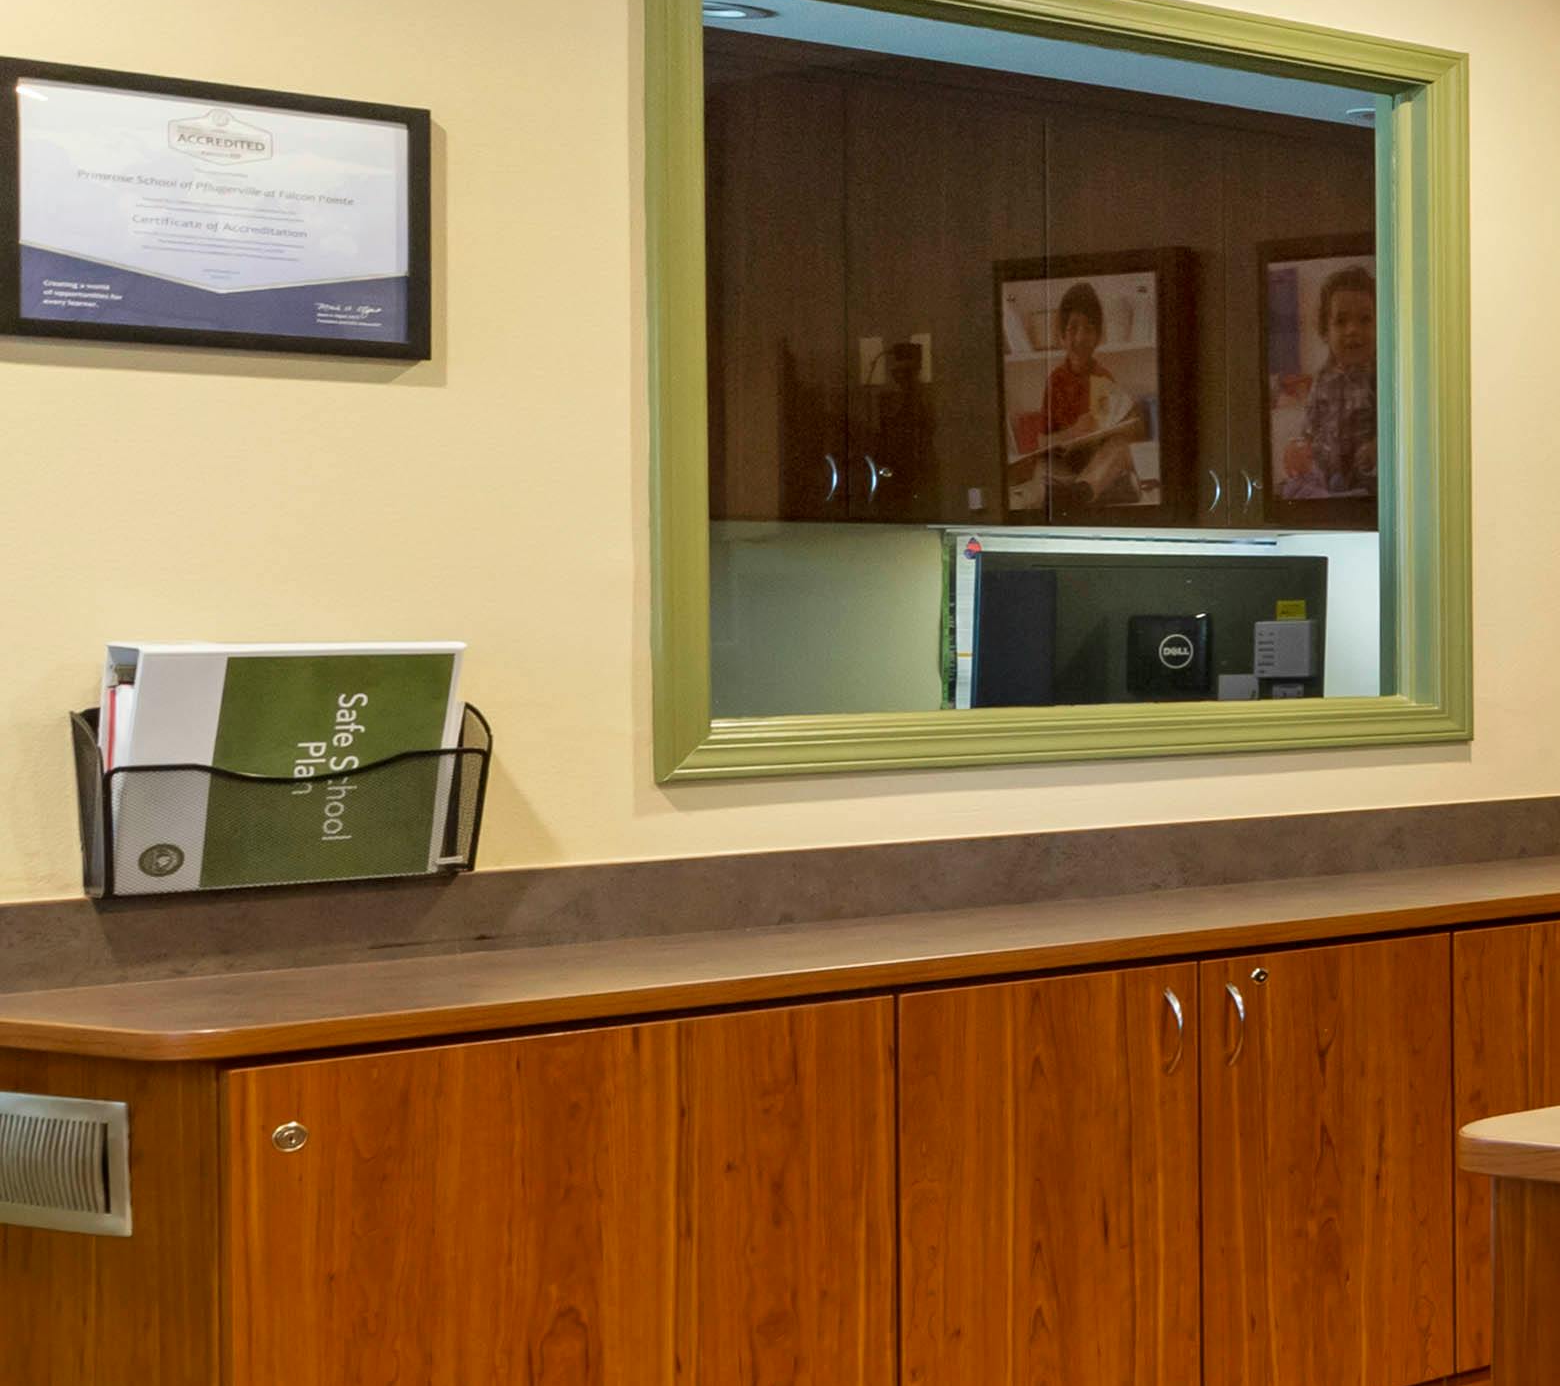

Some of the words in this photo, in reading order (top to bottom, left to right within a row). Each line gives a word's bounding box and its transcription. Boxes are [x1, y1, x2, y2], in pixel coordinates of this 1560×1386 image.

[177, 133, 265, 152] ACCREDITED
[76, 169, 133, 184] Primrose
[137, 174, 177, 189] School
[180, 180, 193, 191] of
[196, 181, 261, 198] Pflugerville
[263, 189, 275, 198] at
[279, 190, 316, 203] Falcon
[318, 194, 355, 206] Pointe
[132, 214, 203, 229] Certificate
[206, 221, 220, 233] of
[223, 222, 307, 239] Accreditation
[1163, 647, 1189, 656] DELL
[332, 692, 368, 748] Safe
[291, 741, 327, 795] Plan
[322, 755, 359, 840] Shool
